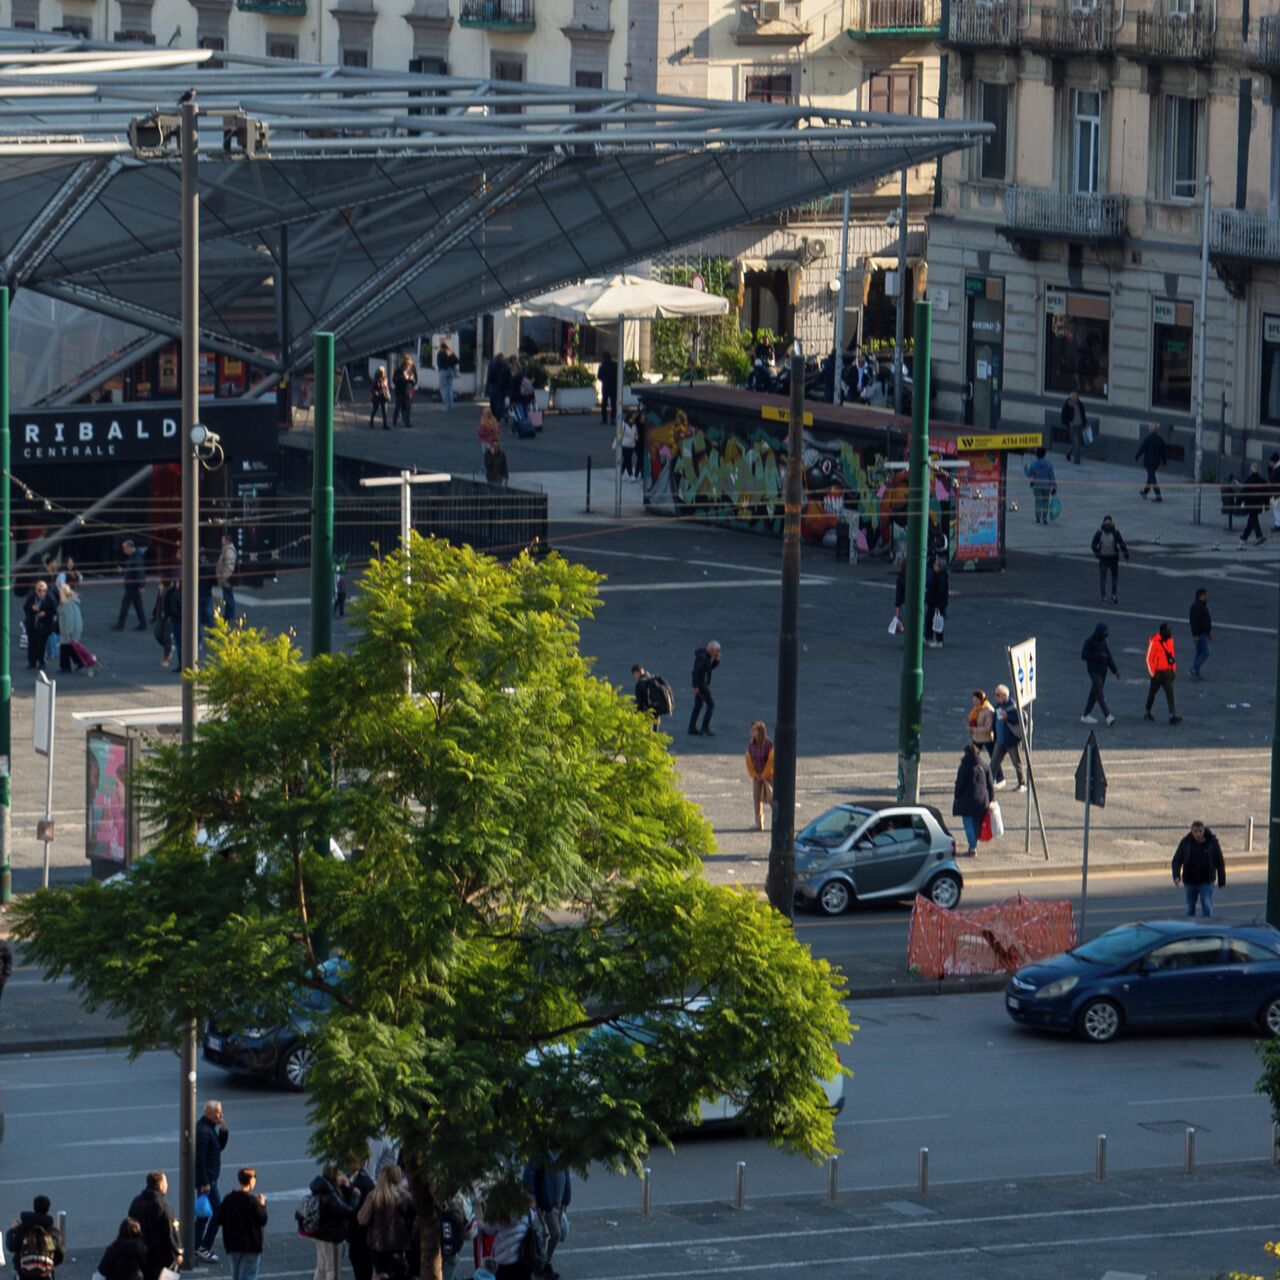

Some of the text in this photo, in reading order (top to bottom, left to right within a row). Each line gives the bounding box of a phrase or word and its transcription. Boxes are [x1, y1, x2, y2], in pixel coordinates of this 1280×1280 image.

[1001, 436, 1018, 446] ATM
[1019, 434, 1039, 445] HERE
[23, 444, 116, 458] CENTRALE
